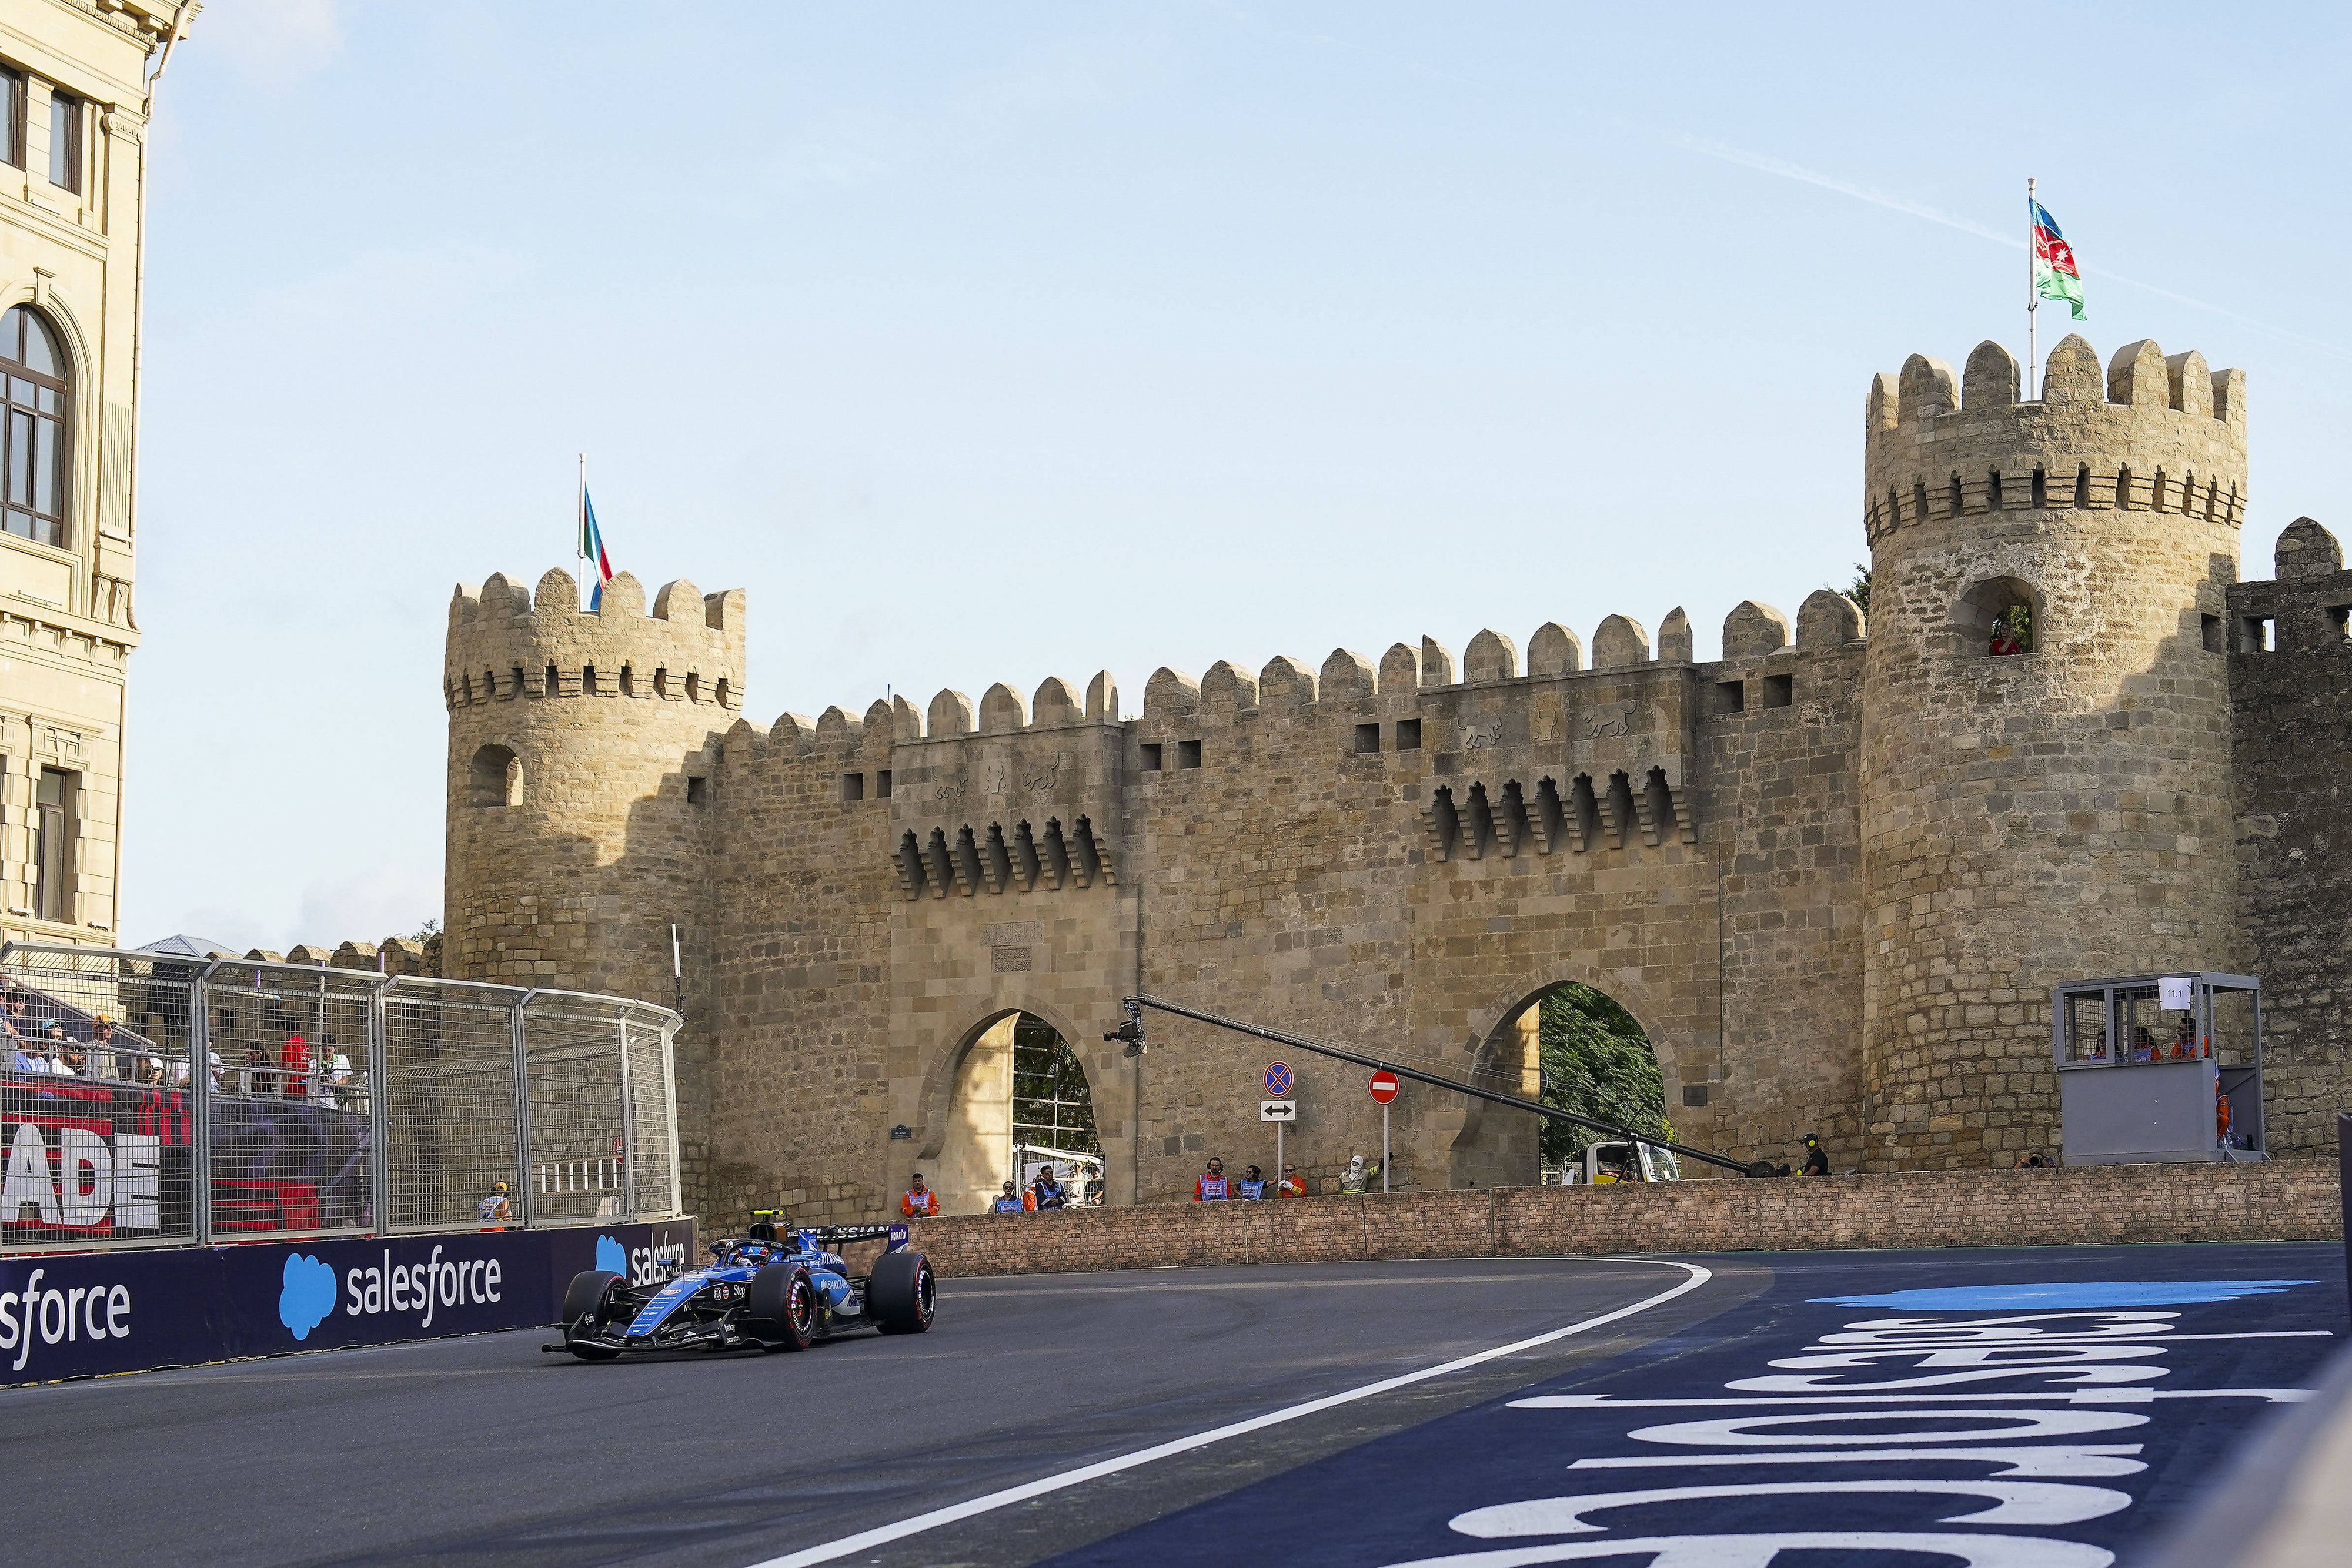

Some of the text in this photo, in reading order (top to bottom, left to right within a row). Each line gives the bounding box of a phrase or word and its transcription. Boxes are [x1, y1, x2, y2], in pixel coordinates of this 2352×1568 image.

[2167, 989, 2181, 998] 11.1
[2, 1123, 160, 1229] ADE
[0, 1268, 131, 1371] sforce
[346, 1245, 501, 1328] salesforce
